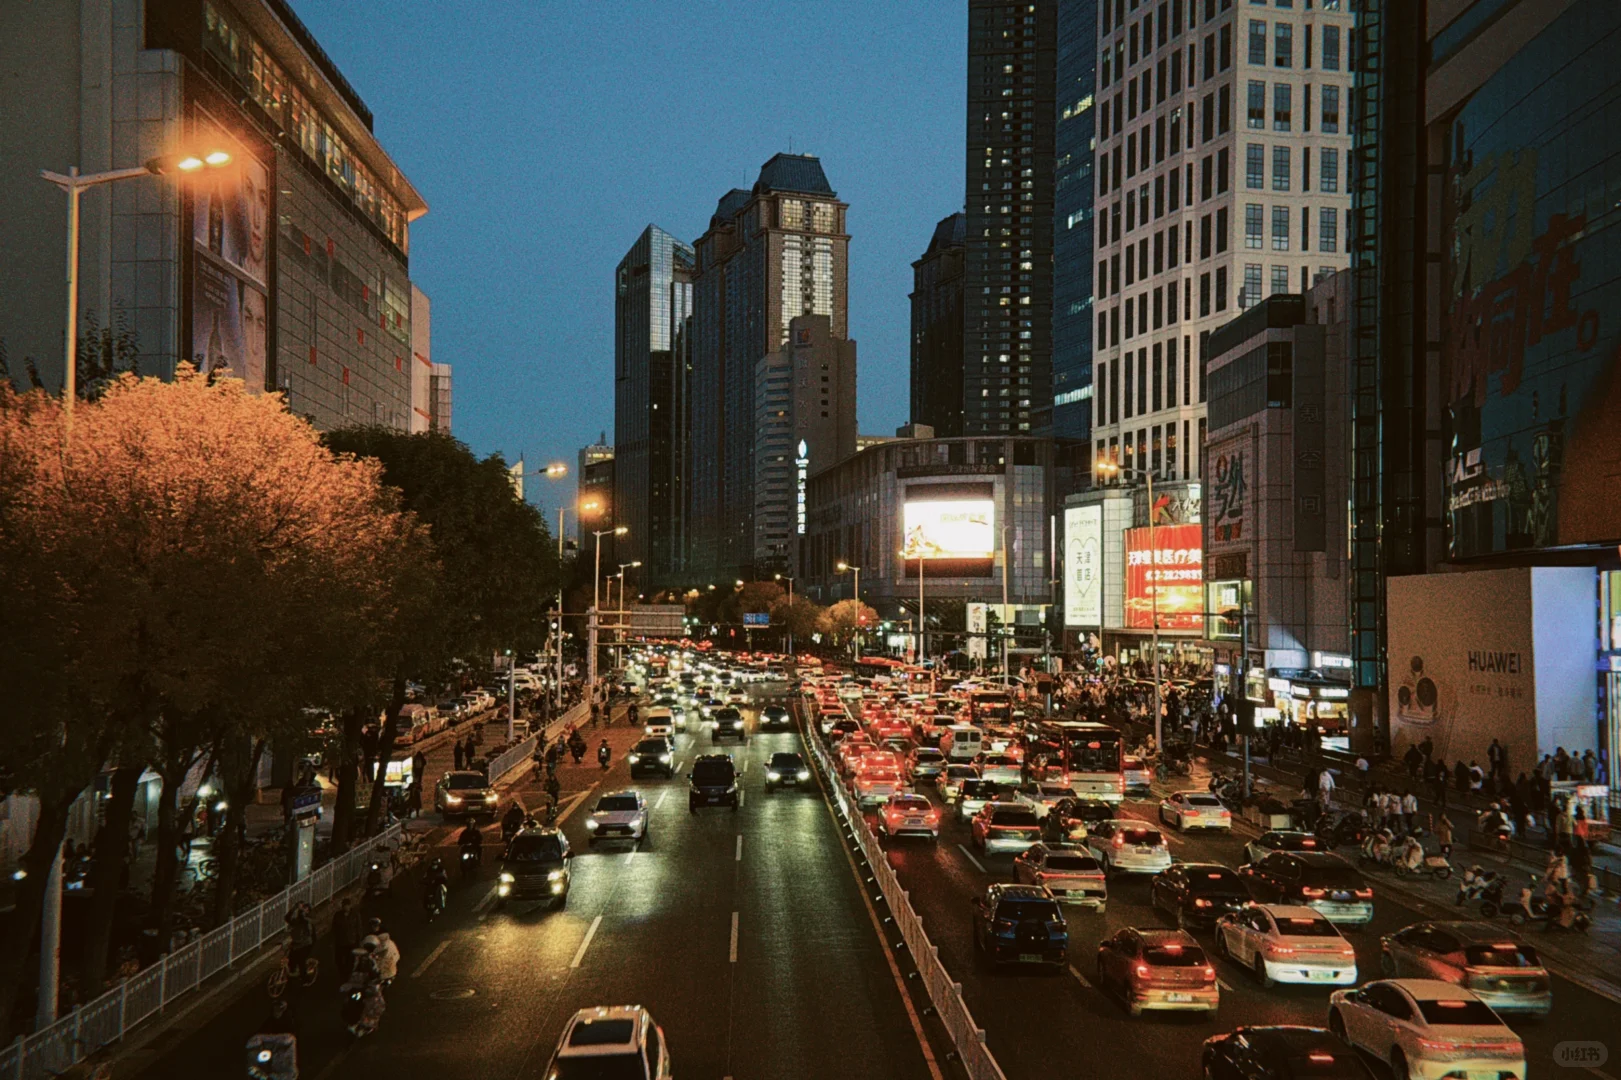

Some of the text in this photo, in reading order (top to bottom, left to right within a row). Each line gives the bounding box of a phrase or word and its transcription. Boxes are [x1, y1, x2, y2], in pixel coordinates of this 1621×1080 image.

[1299, 403, 1322, 515] 氪空间
[1468, 650, 1521, 674] HUAWEI
